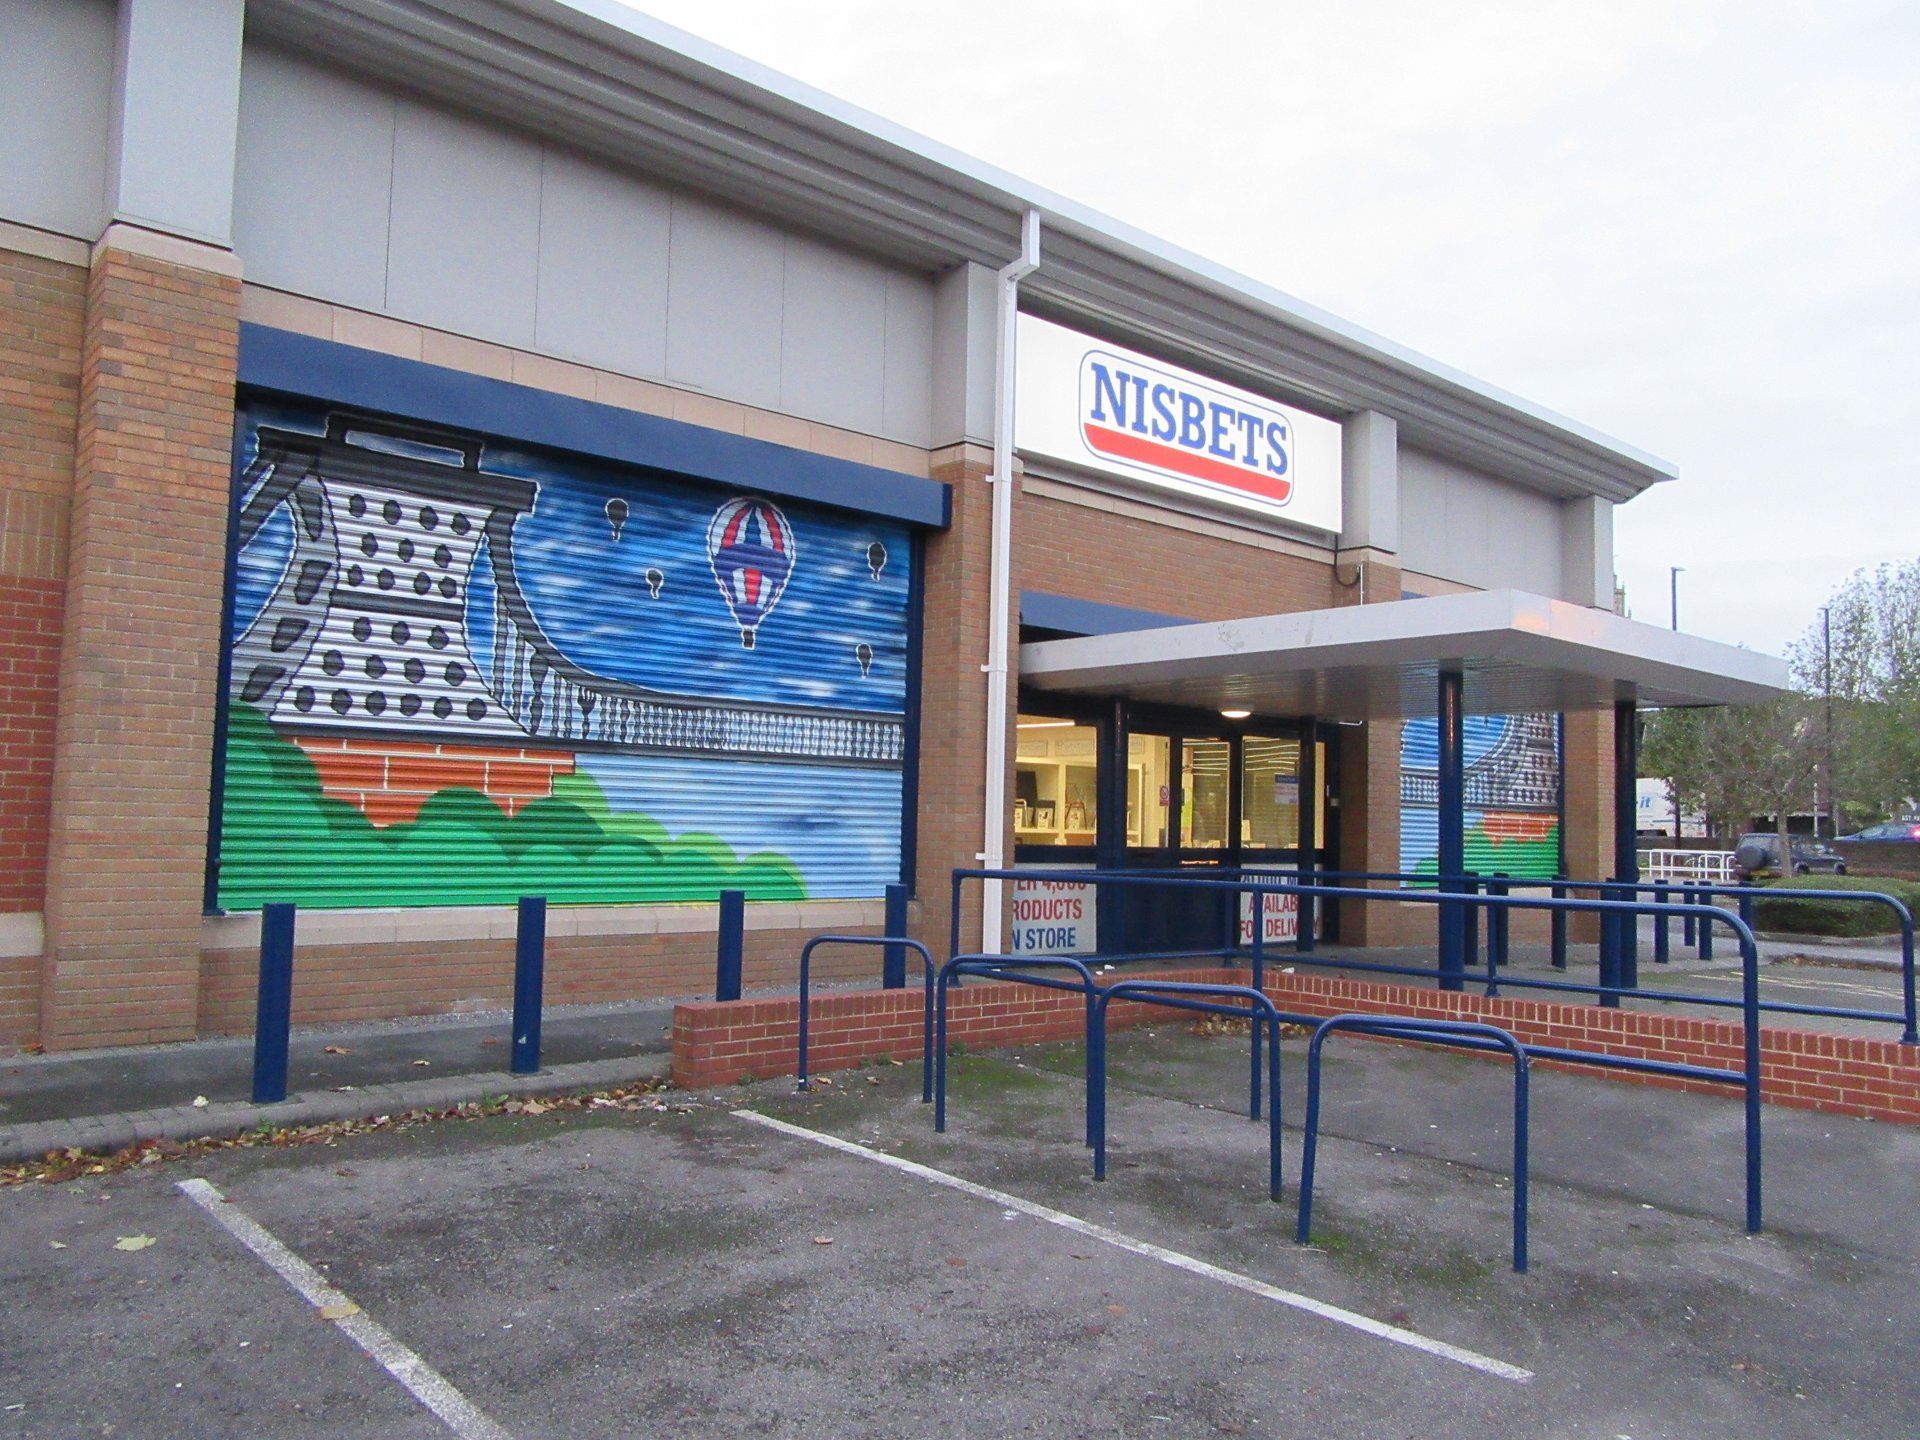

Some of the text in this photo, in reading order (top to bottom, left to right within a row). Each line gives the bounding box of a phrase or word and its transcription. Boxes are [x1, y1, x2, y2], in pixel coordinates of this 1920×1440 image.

[1090, 363, 1288, 475] NISBETS
[1248, 895, 1299, 914] AAILAB
[1025, 927, 1076, 950] STORE
